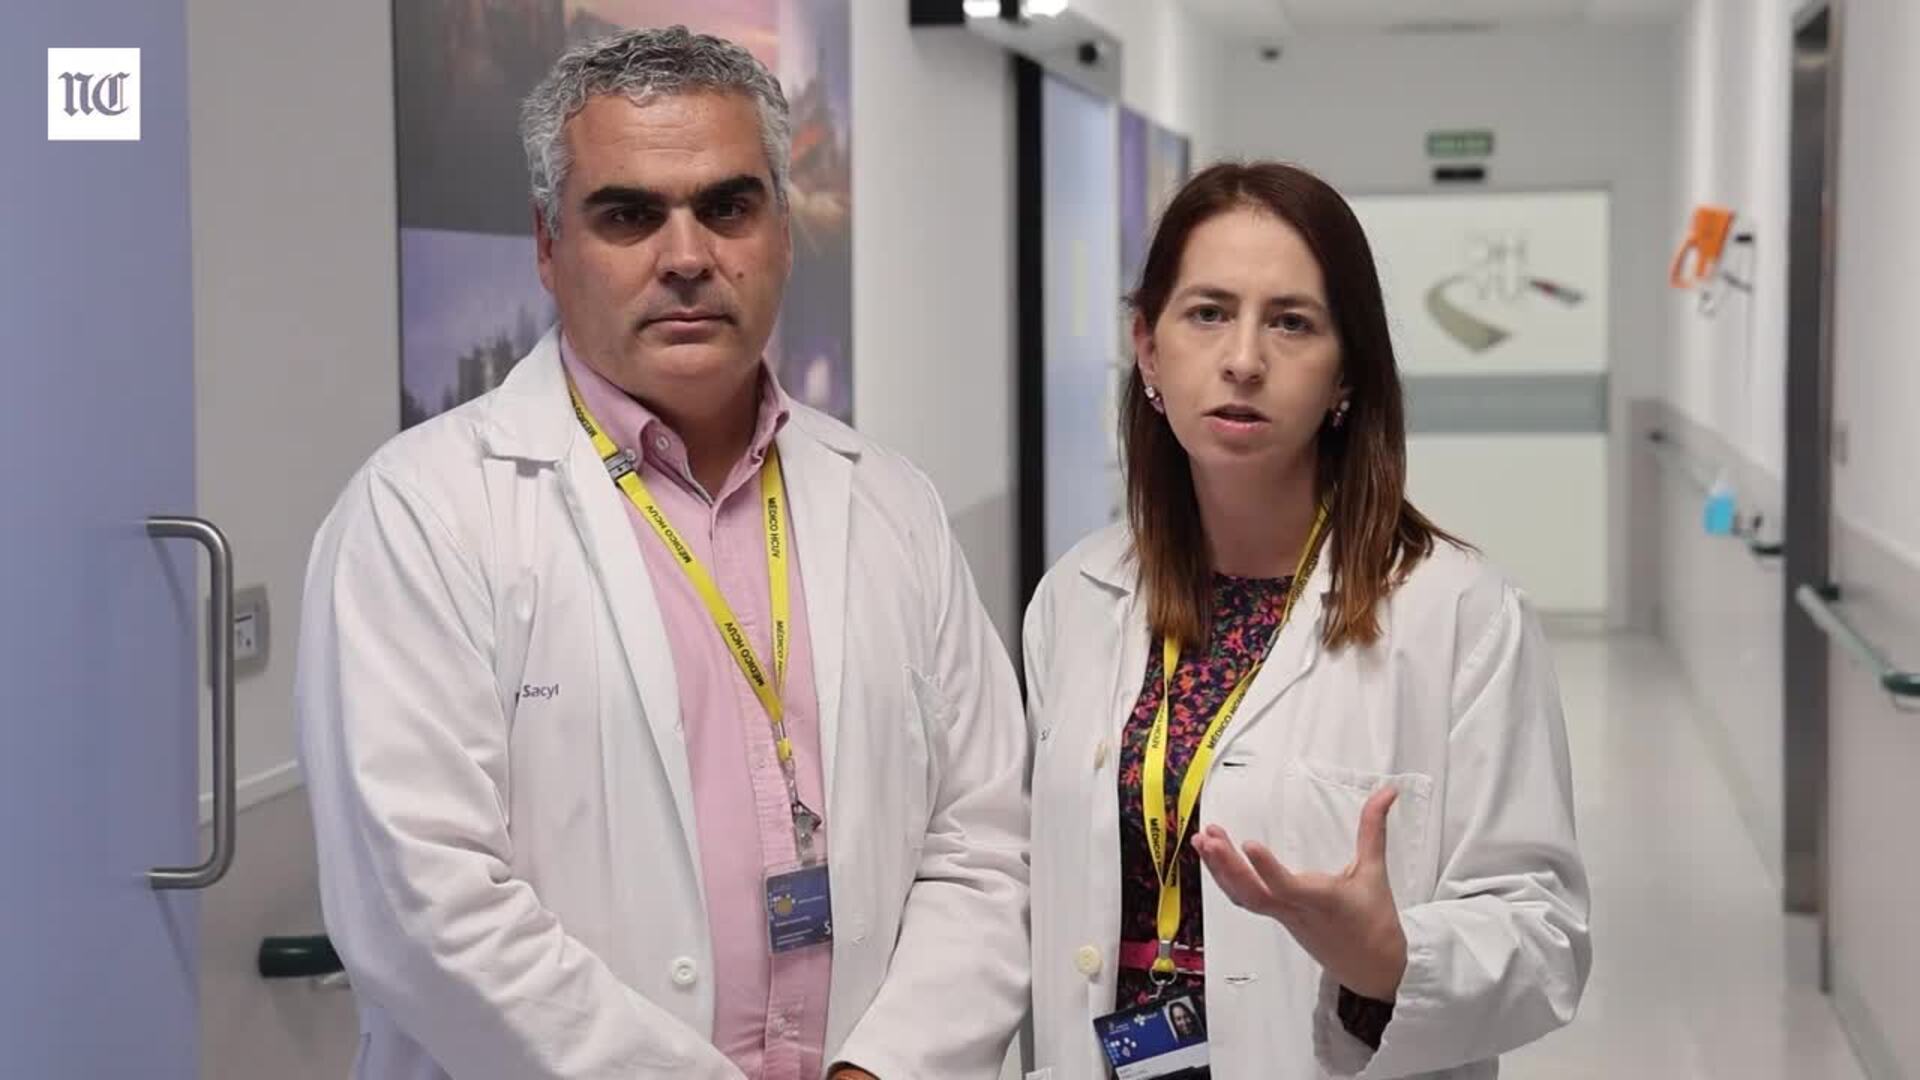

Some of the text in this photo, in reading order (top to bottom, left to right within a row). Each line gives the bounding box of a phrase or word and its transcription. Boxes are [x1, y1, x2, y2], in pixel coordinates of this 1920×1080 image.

[645, 505, 692, 564] MÉDICO HCUV
[768, 497, 780, 559] MÉDICO HCUV
[724, 622, 765, 686] MÉDICO HCUV
[522, 683, 560, 700] Sacyl
[1206, 715, 1232, 749] MÉDICO
